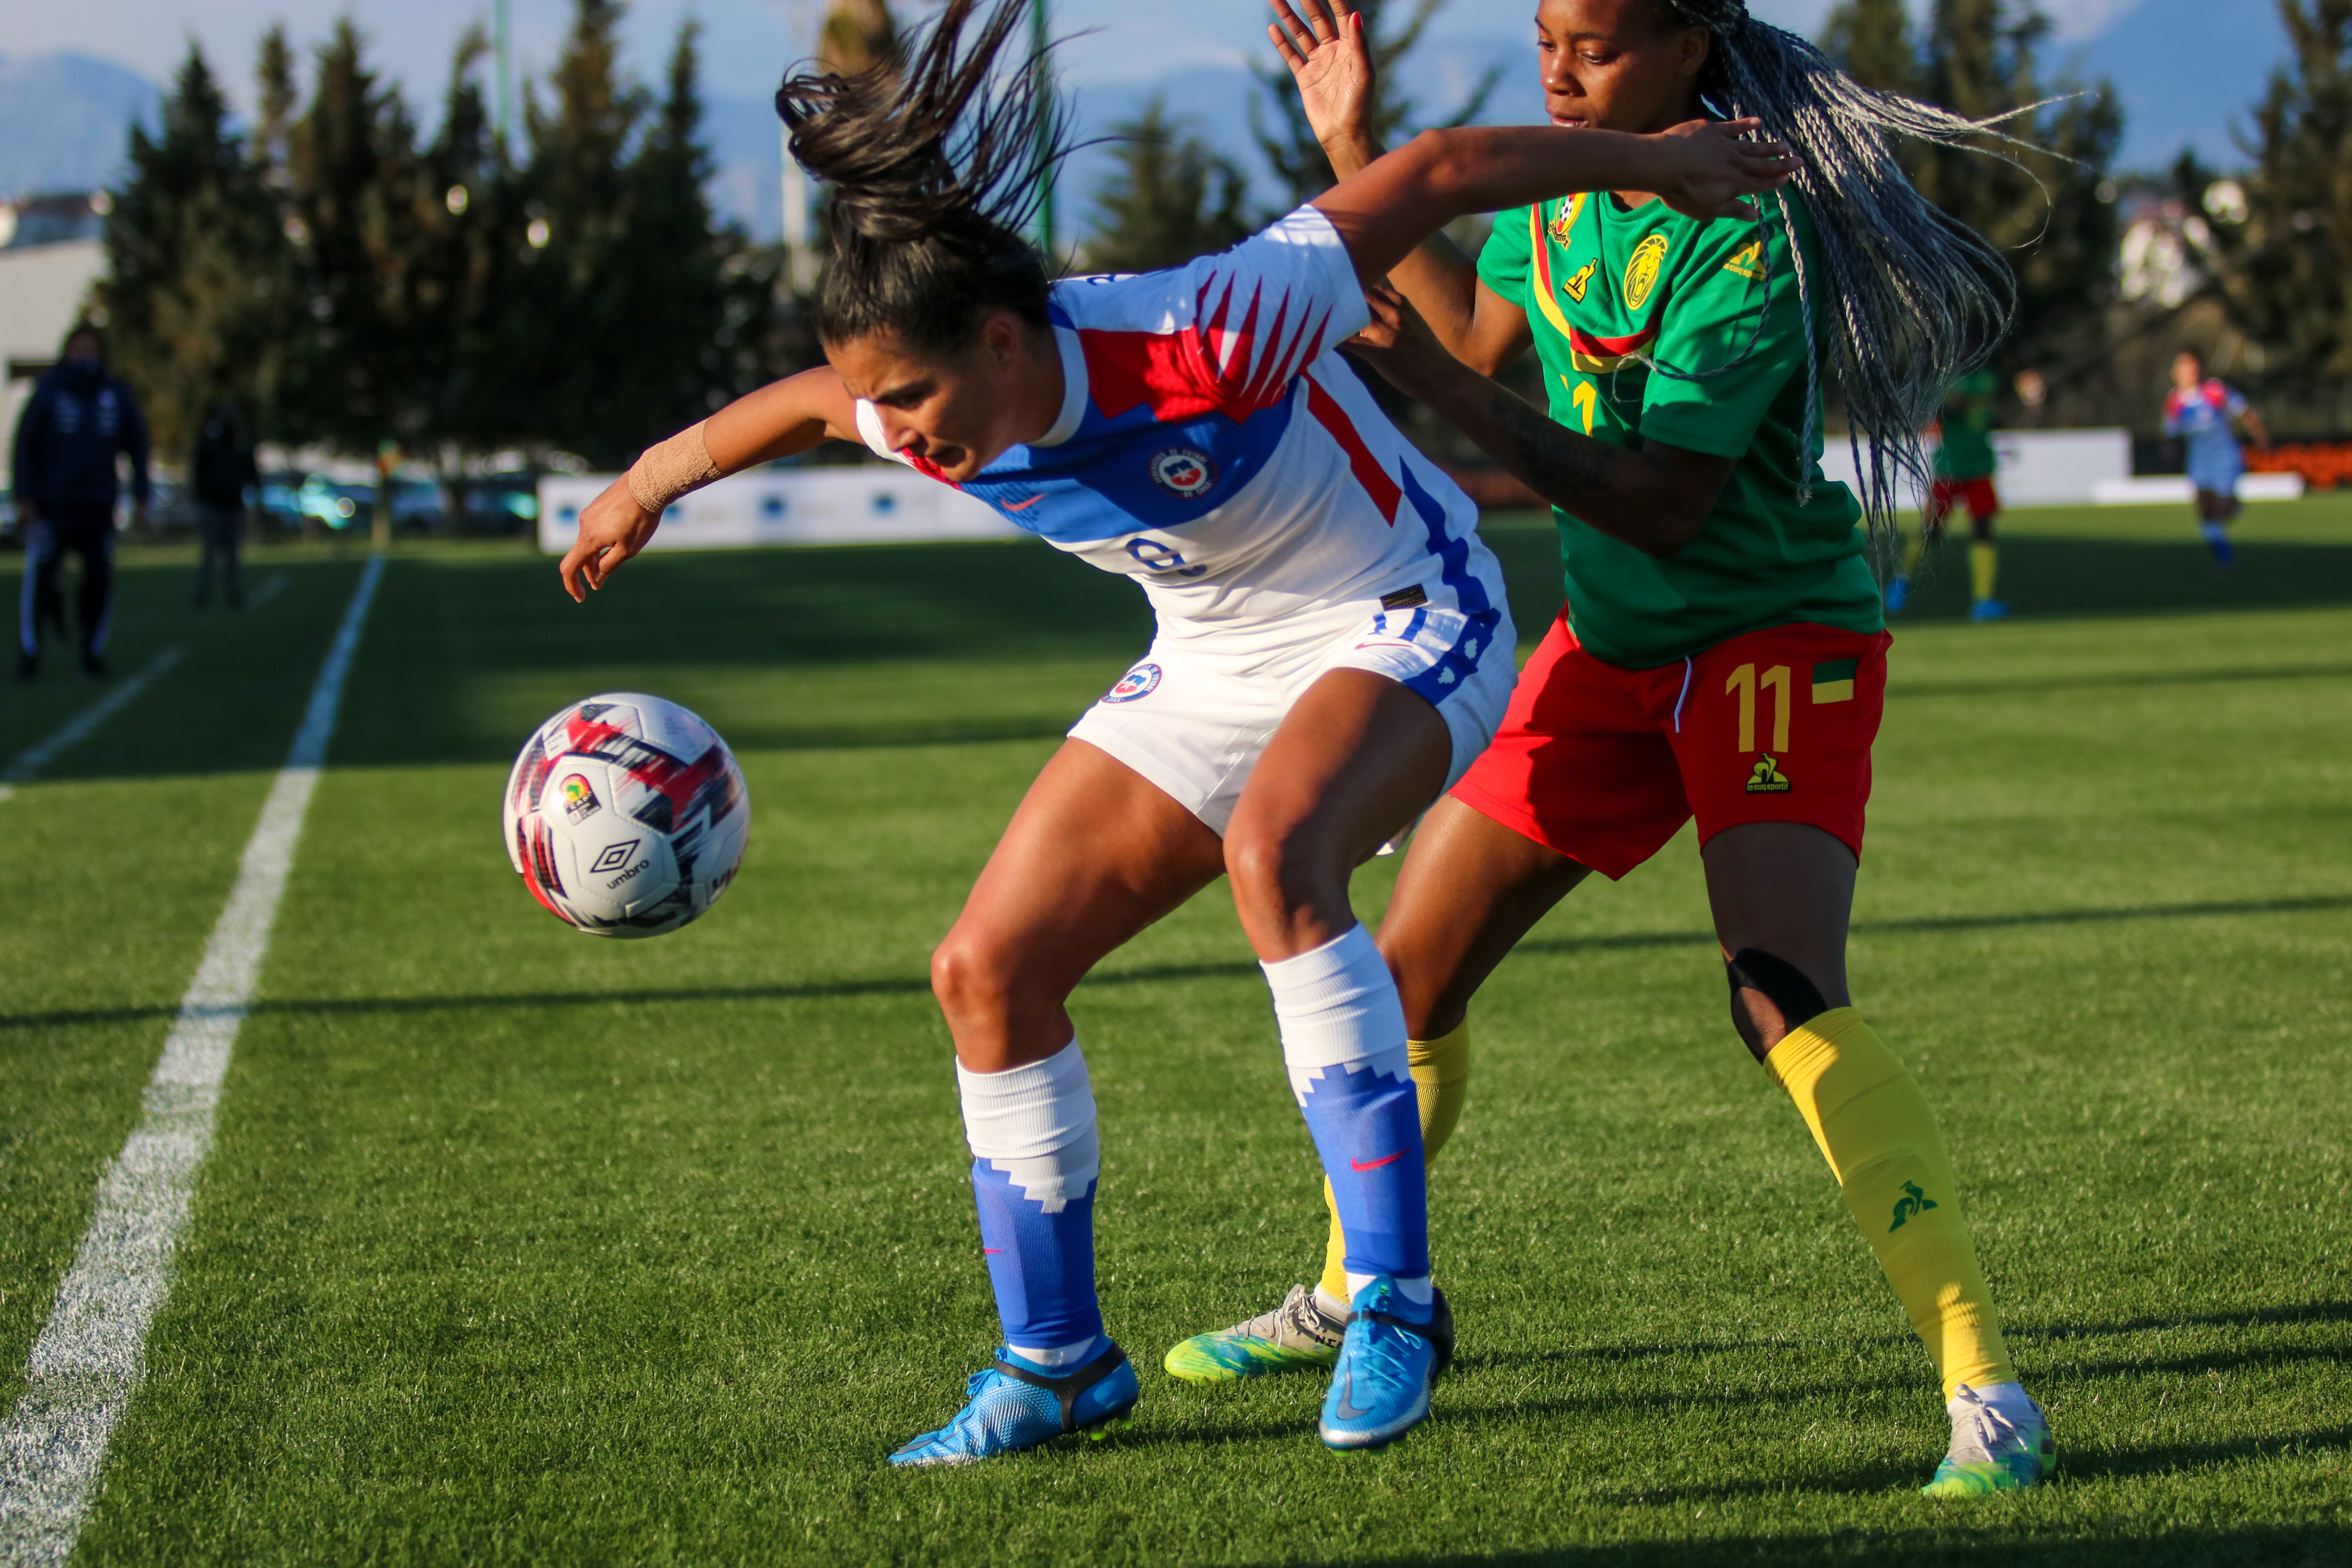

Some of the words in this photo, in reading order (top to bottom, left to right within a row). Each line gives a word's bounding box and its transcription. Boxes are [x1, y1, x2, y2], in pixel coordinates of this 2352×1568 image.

[1143, 673, 1160, 692] FUTBOL
[1726, 663, 1791, 753] 11
[1767, 782, 1789, 791] sportif
[606, 859, 650, 889] umbro
